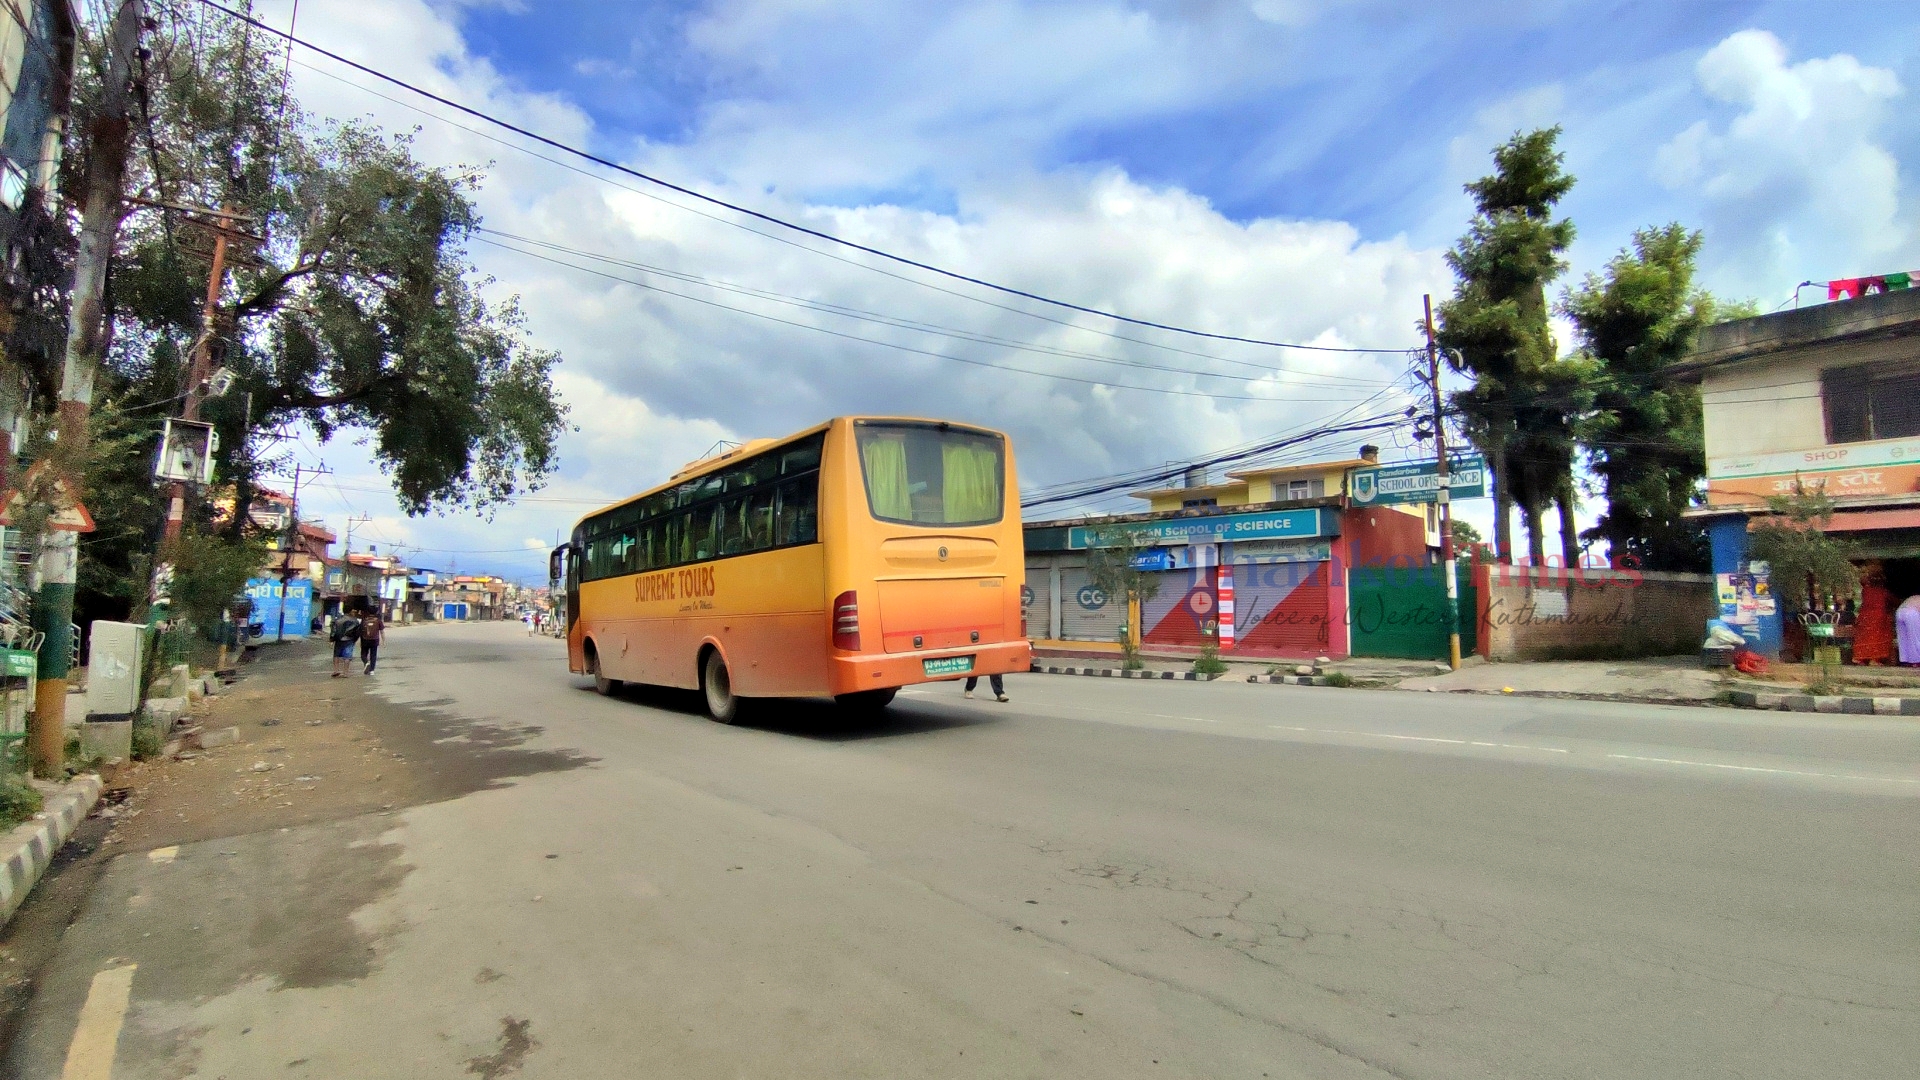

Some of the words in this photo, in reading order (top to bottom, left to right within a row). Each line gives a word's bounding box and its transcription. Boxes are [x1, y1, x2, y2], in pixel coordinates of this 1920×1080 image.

[1804, 449, 1848, 462] SHOP
[1378, 467, 1421, 478] Sundarban
[1380, 477, 1417, 491] SCHOOL
[1418, 476, 1432, 488] OF
[1433, 471, 1479, 487] SENCE
[1165, 524, 1211, 536] SCHOOL
[1215, 523, 1231, 533] OF
[1234, 518, 1292, 532] SCIENCE
[635, 572, 675, 602] SUPREME
[678, 565, 715, 598] TOURS
[1080, 590, 1103, 604] CG
